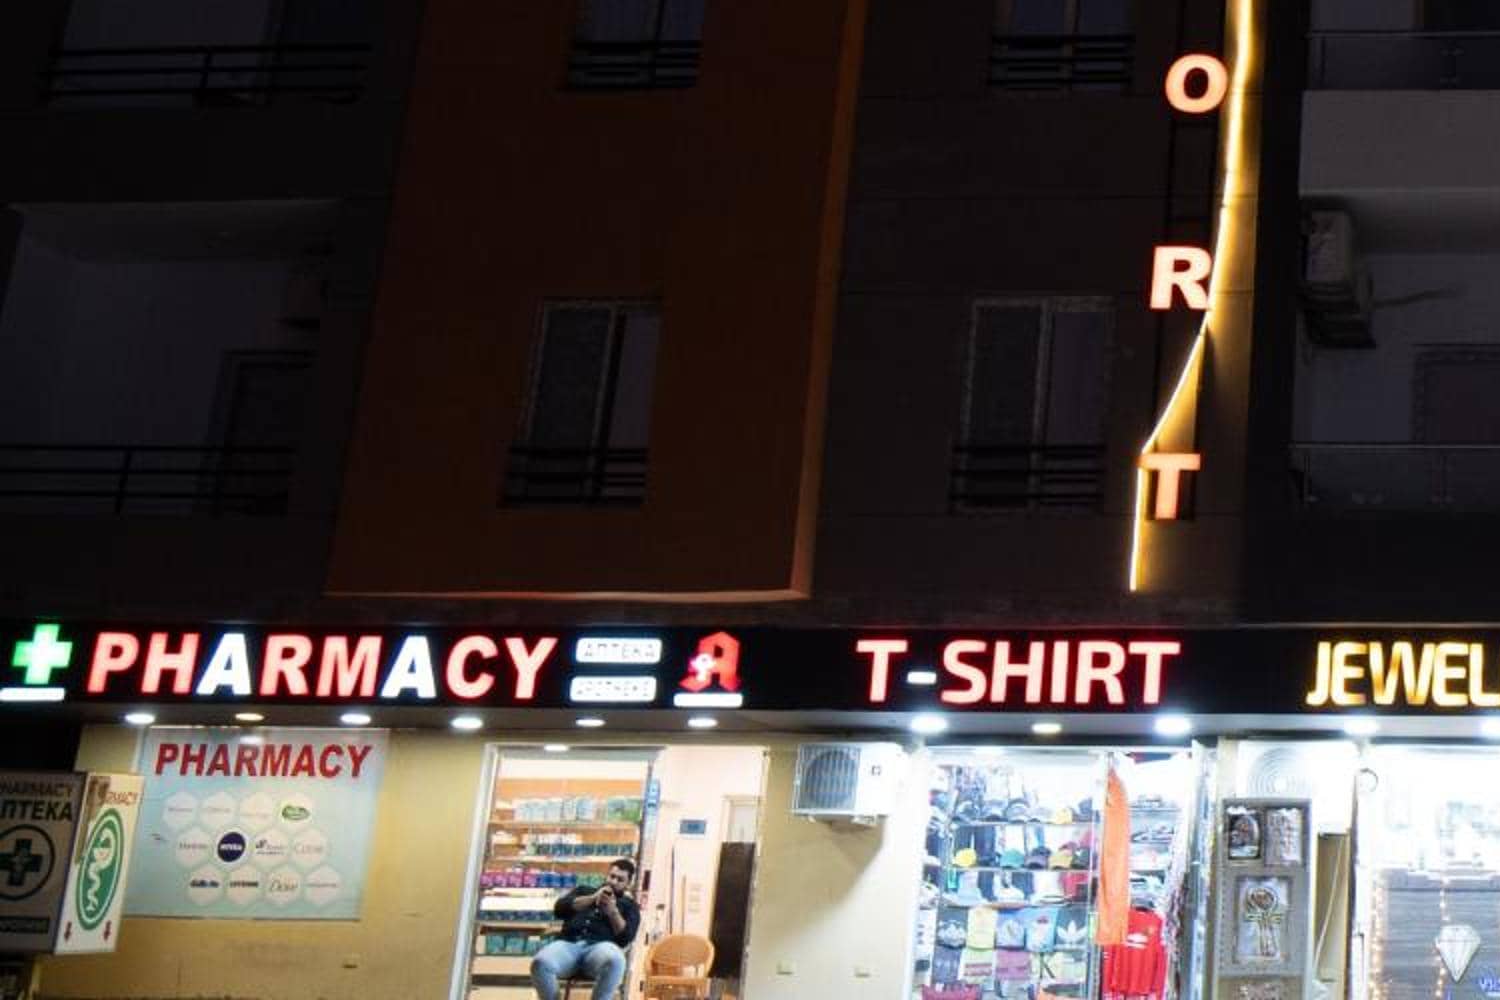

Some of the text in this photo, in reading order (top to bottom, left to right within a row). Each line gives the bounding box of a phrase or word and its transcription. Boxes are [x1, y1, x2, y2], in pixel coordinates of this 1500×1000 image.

[87, 631, 558, 699] PHARMACY
[857, 639, 1180, 705] T-SHIRT
[155, 743, 373, 778] PHARMACY
